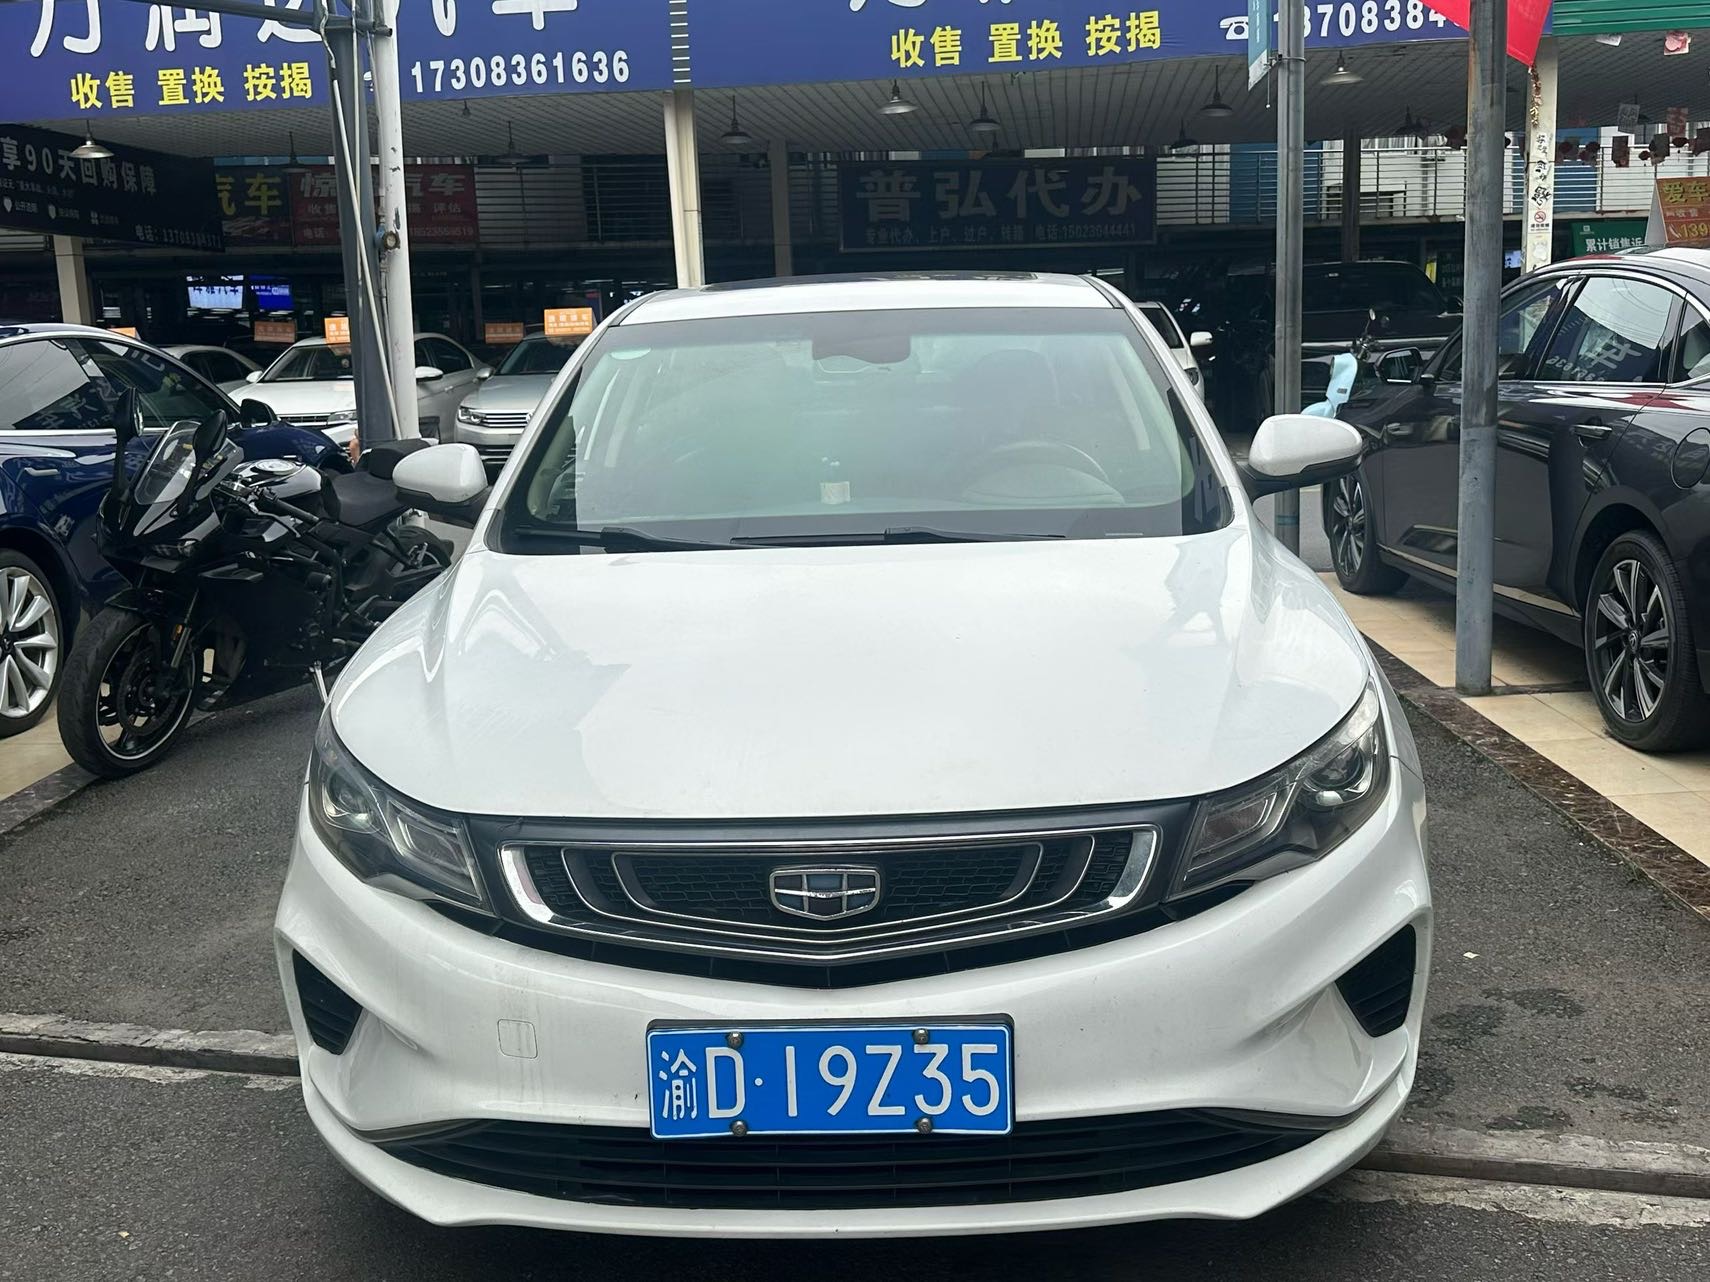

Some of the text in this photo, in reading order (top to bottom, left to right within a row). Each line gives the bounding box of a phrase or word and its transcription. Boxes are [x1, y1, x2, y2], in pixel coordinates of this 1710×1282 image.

[888, 10, 1162, 68] 收售 置换 按揭
[70, 61, 313, 110] 收售 置换 按揭
[411, 50, 630, 93] 17308361636
[855, 165, 1142, 224] 普弘代办
[658, 1043, 1001, 1120] 渝D·19Z35
